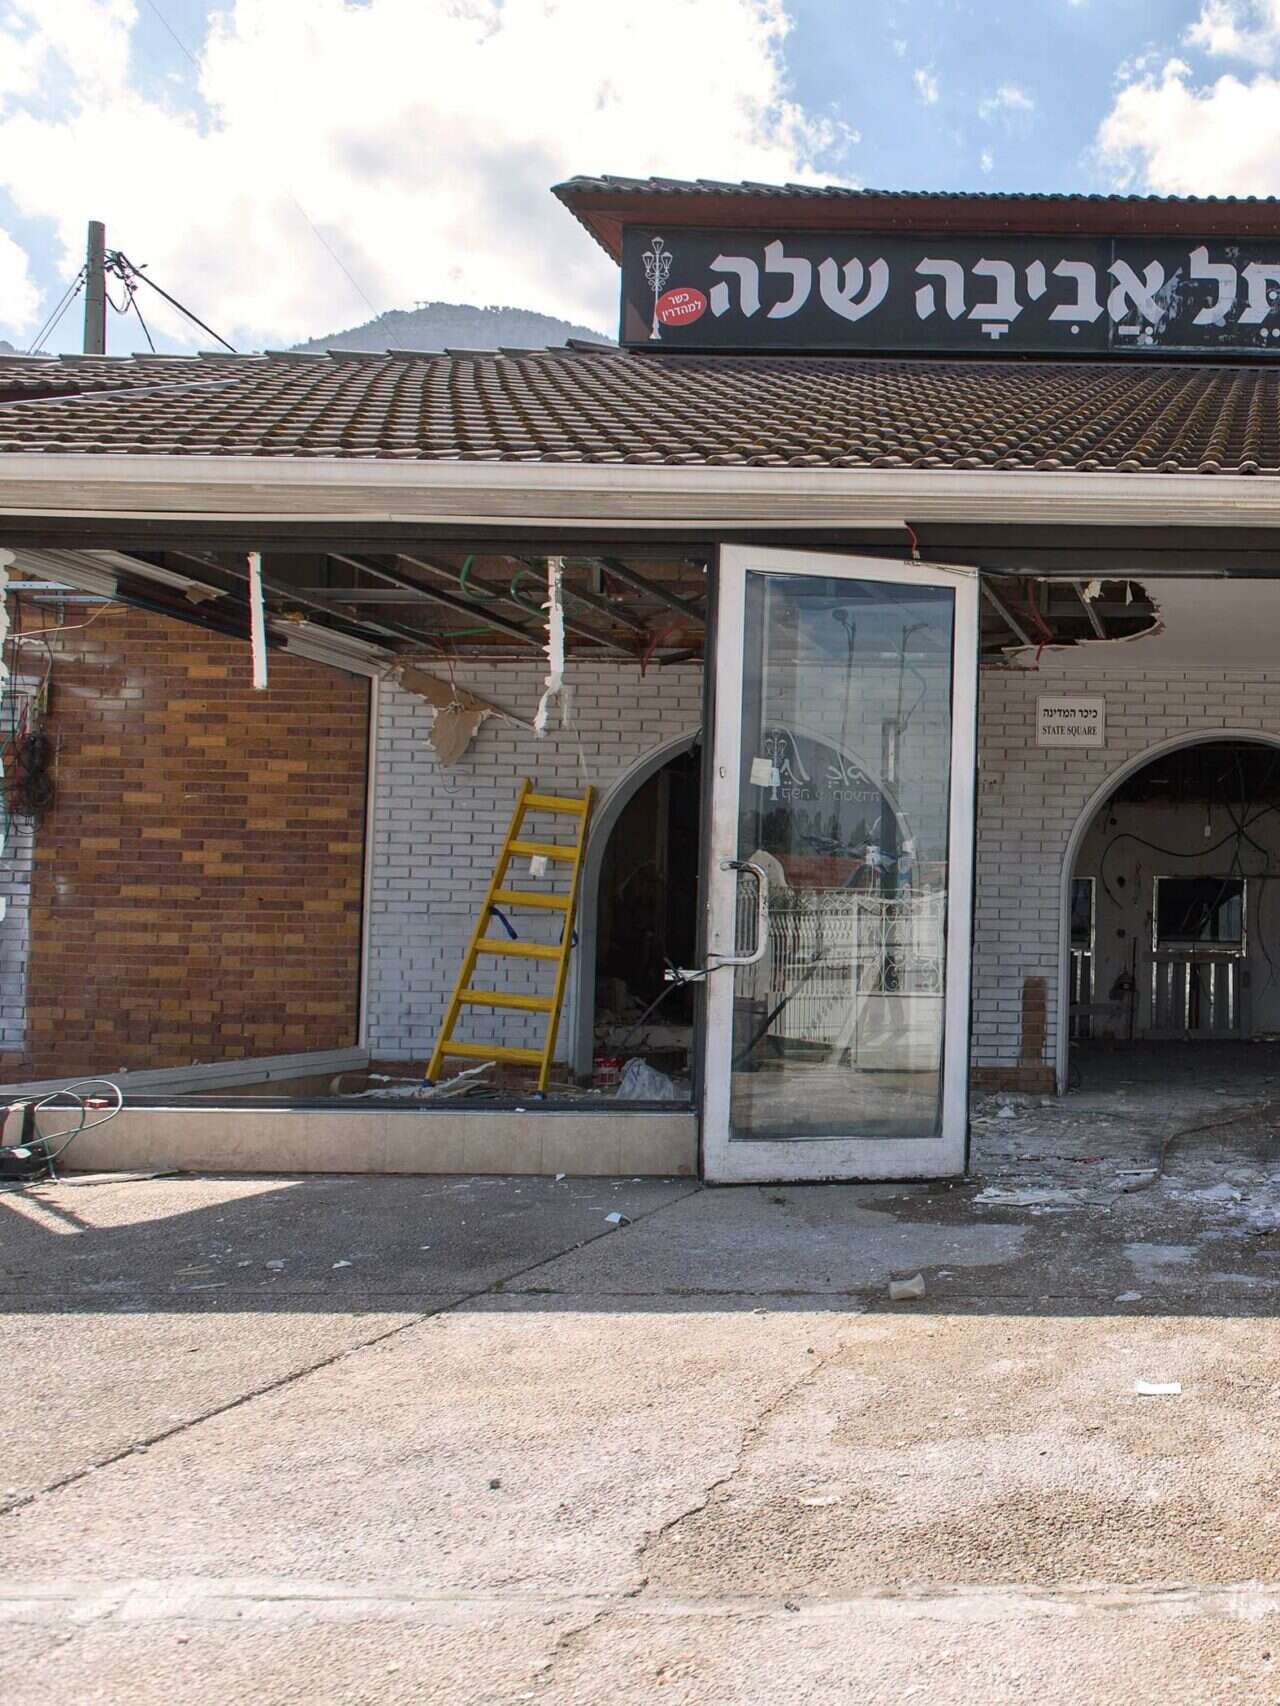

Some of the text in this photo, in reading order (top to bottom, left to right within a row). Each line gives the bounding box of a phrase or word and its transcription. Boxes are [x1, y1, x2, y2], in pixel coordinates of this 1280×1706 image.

[709, 239, 890, 322] שלה
[668, 293, 689, 304] כשר
[662, 300, 702, 322] למהדרין
[1043, 708, 1098, 718] כיכר המדינה
[1042, 725, 1097, 736] STATE SQUARE
